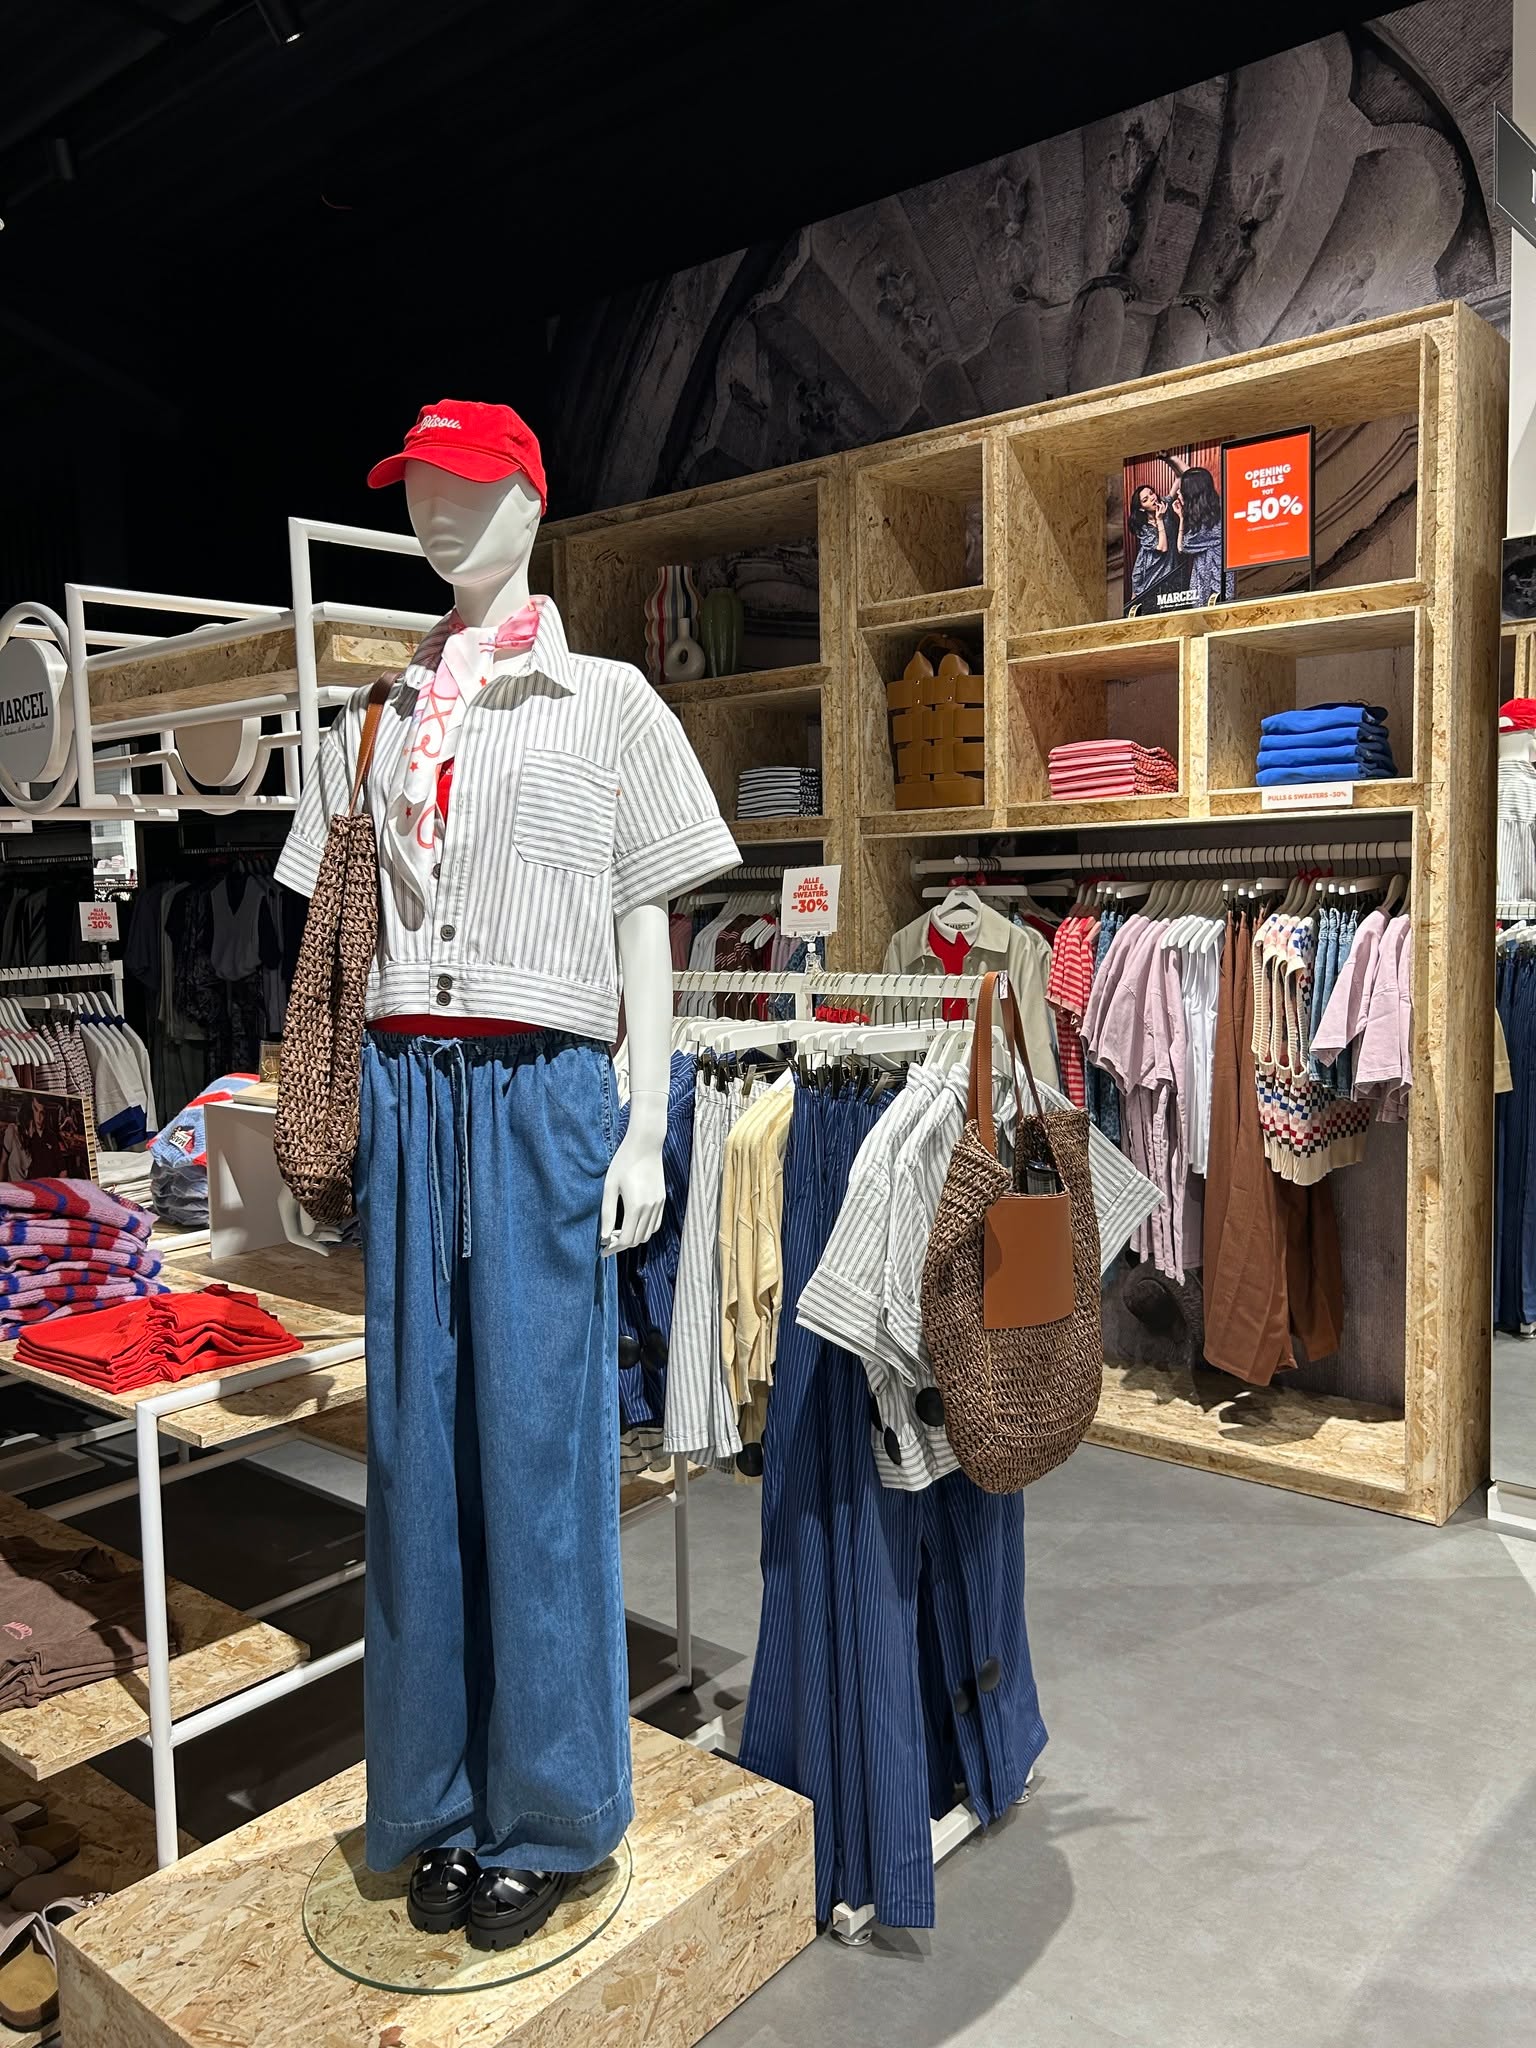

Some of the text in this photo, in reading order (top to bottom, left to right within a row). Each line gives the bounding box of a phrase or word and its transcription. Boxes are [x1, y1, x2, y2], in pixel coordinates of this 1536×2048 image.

[1244, 464, 1291, 480] OPENING
[1252, 475, 1284, 488] DEALS
[1233, 495, 1303, 523] -50%
[1156, 589, 1200, 605] MARCEL
[1294, 791, 1329, 800] SWEATERS
[793, 890, 828, 898] SWEATERS
[791, 898, 829, 913] -30%
[88, 921, 112, 929] -30%
